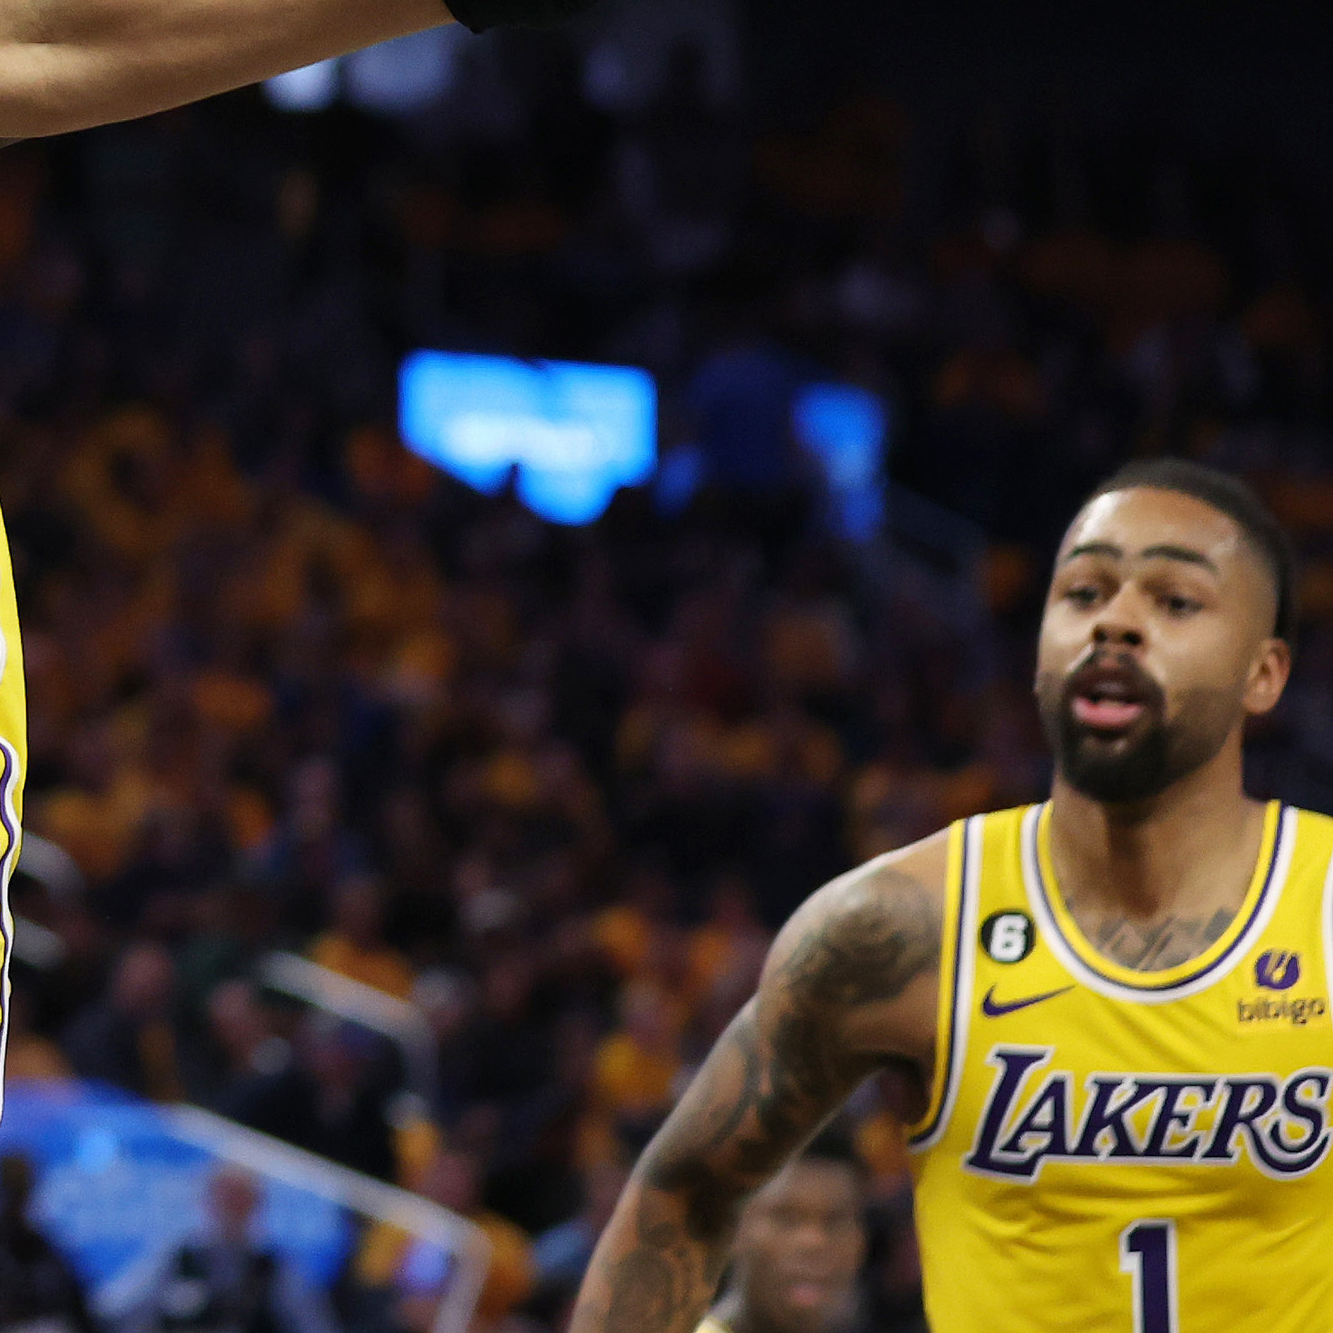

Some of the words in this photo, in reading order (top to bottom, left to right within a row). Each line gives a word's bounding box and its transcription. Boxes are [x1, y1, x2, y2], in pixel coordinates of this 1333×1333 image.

[989, 913, 1029, 963] 6
[964, 1044, 1333, 1186] LAKERS
[1119, 1217, 1180, 1333] 1
